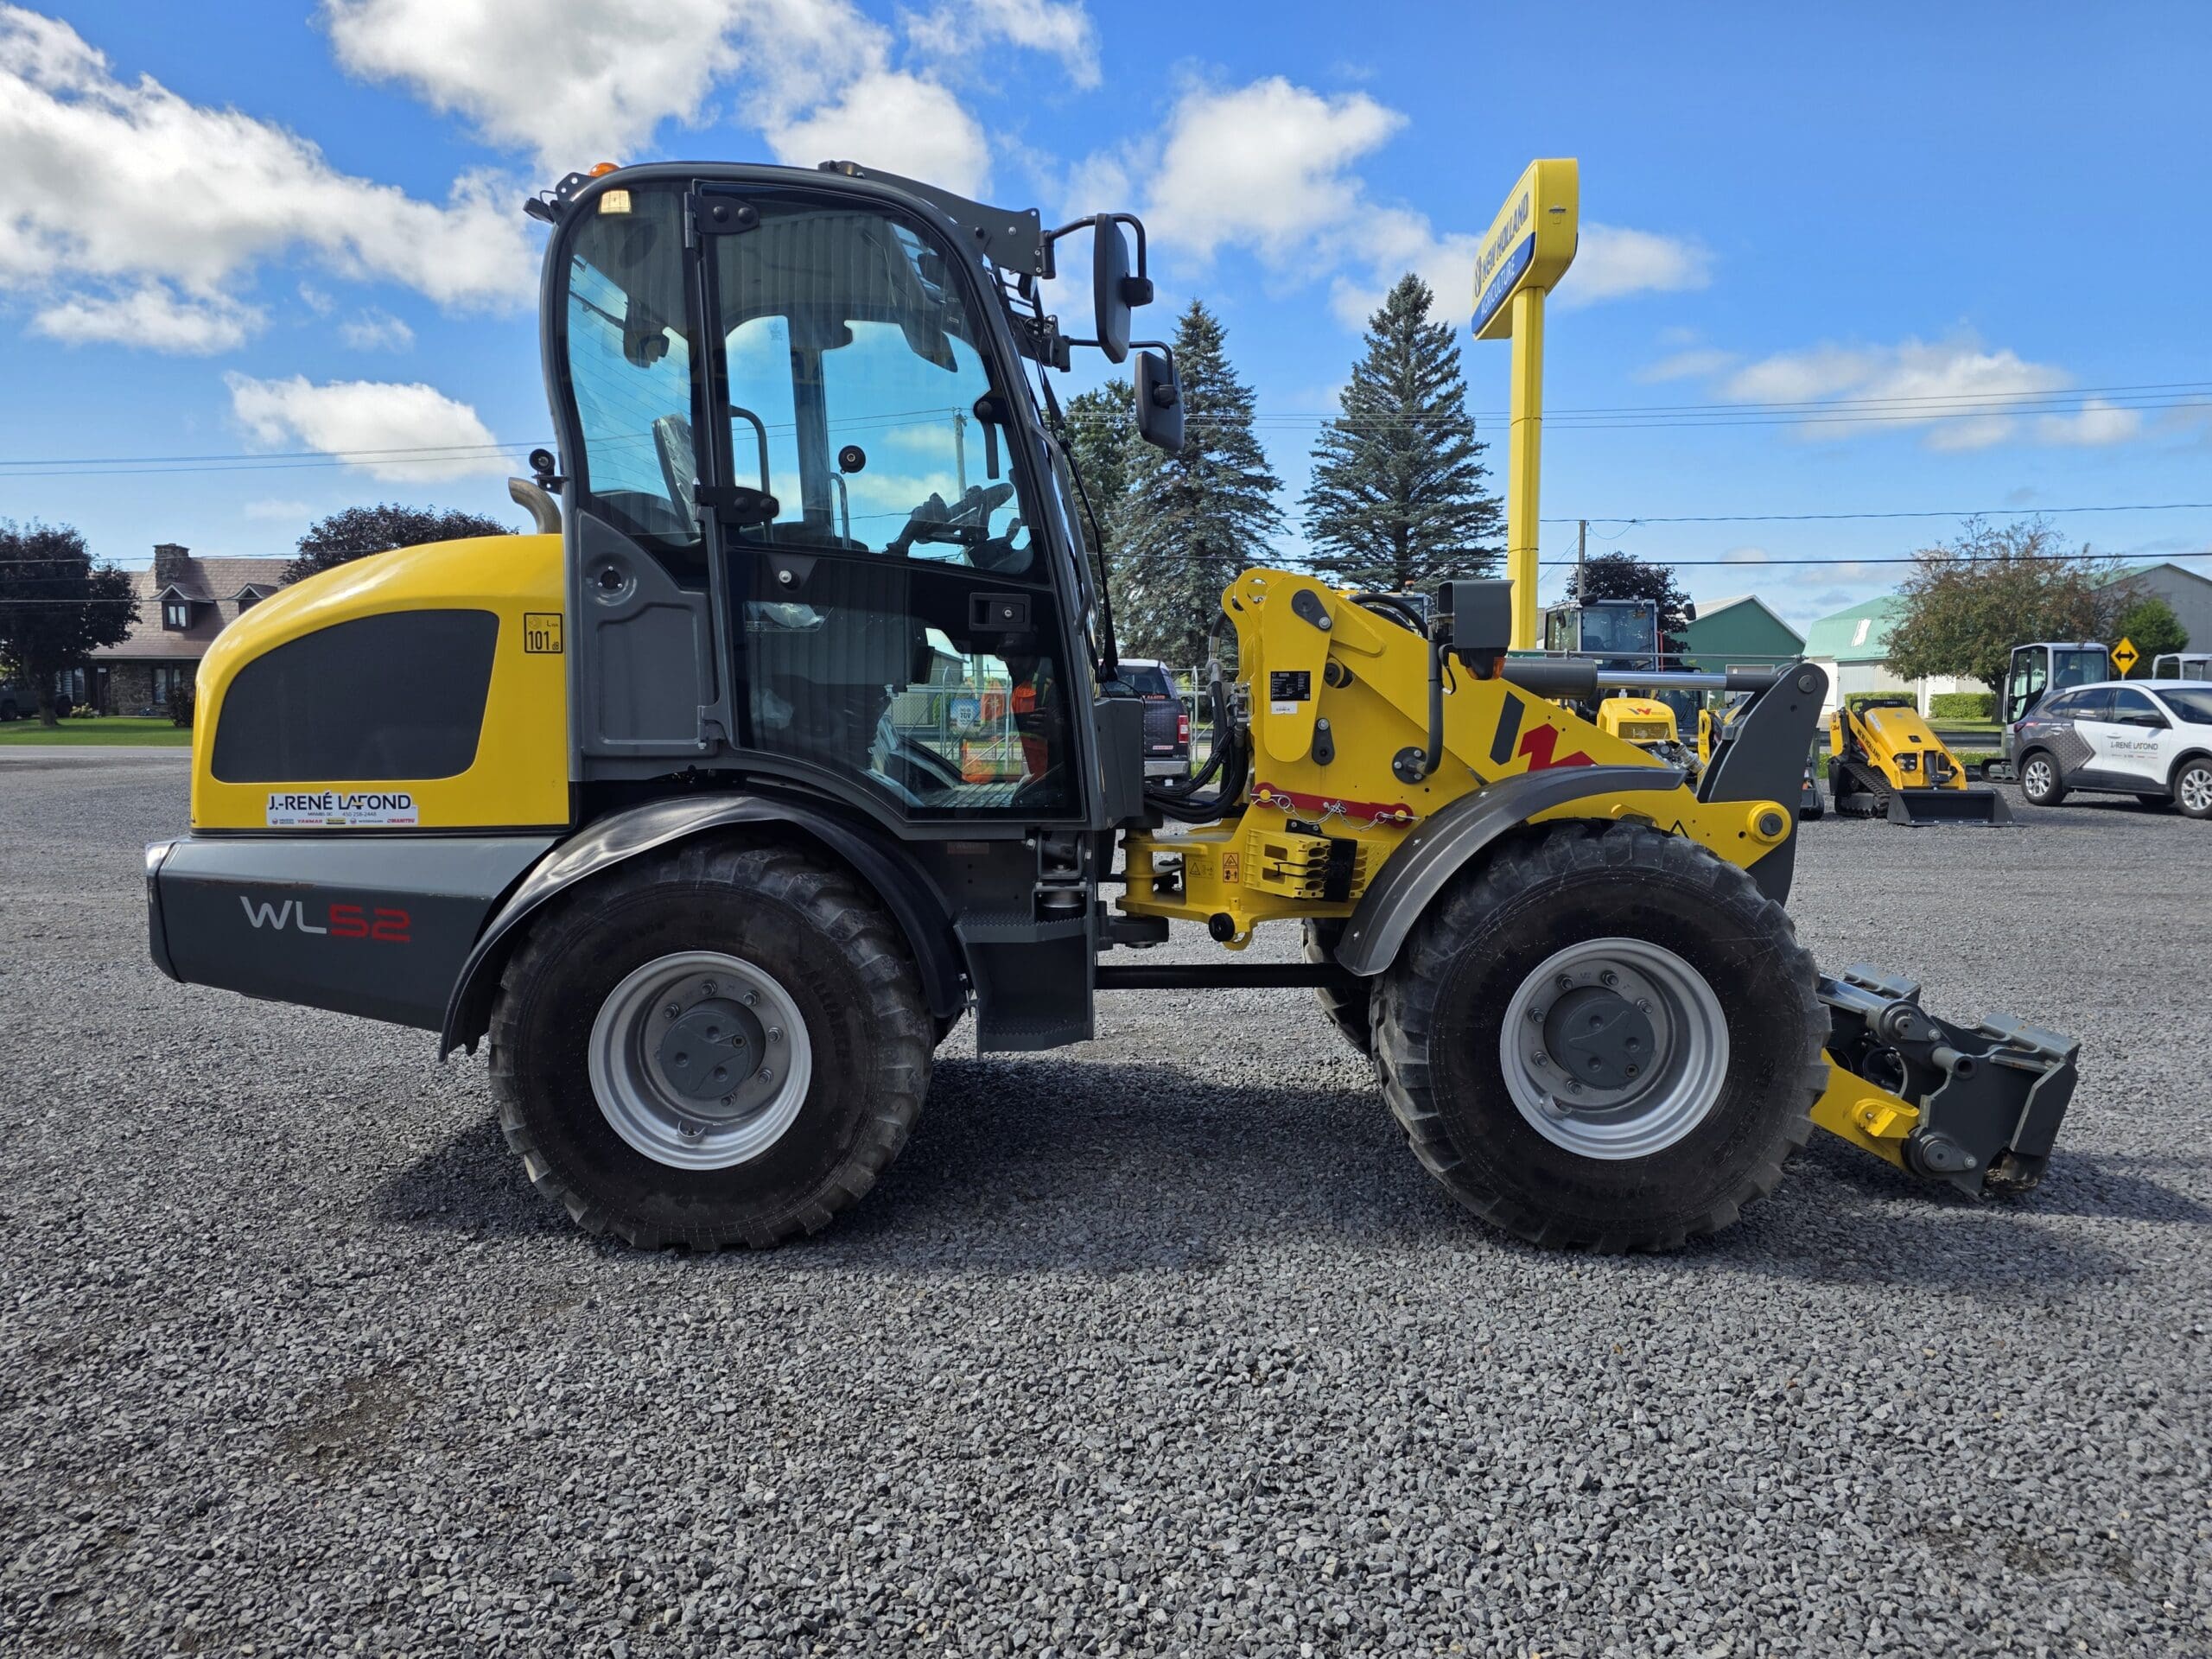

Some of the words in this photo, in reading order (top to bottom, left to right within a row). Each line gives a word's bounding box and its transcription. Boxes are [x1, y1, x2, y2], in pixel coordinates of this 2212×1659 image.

[1482, 241, 1497, 283] NEW
[1497, 192, 1529, 261] HOLLAND
[1480, 255, 1516, 319] AGRICULTURE
[528, 631, 549, 650] 101
[1866, 739, 1881, 761] HOLLAND
[269, 791, 333, 810] J.-RENÉ
[338, 795, 410, 810] LAFOND
[239, 896, 411, 942] WL52
